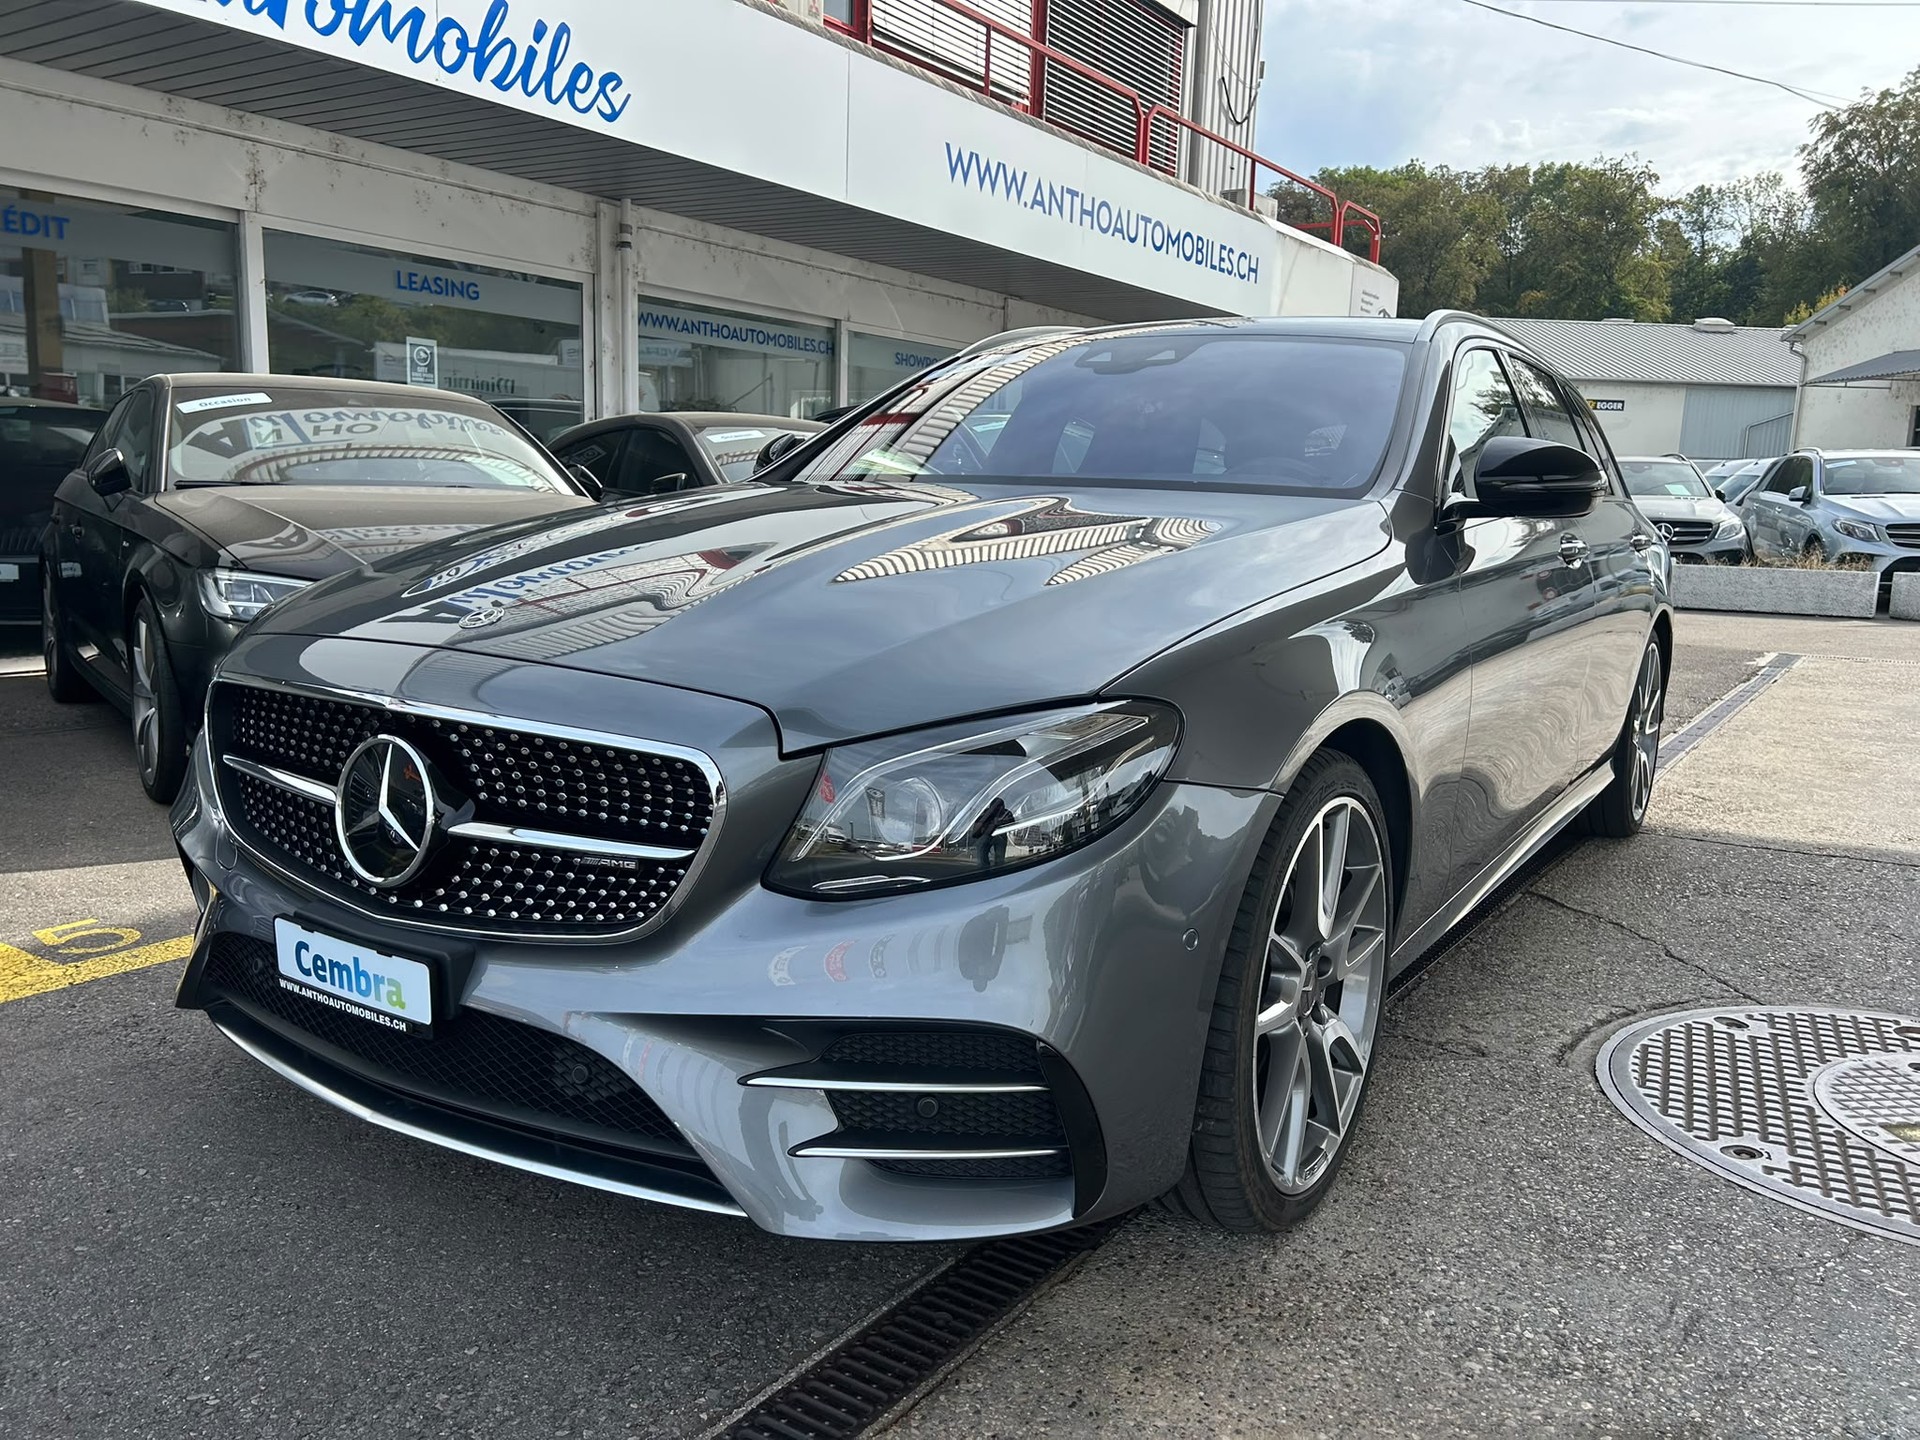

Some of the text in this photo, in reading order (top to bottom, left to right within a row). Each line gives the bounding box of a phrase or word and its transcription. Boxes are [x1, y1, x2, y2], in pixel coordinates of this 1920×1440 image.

[216, 0, 631, 123] omobiles
[945, 142, 1259, 284] WWW.ANTHOAUTOMOBILES.CH
[396, 270, 480, 300] LEASING
[638, 311, 835, 356] WWW.ANTHOAUTOMOBILES.CH
[895, 352, 943, 368] SHOWR
[199, 397, 252, 407] Occasion
[1596, 401, 1623, 410] EGGER
[597, 858, 637, 870] AMG
[32, 917, 142, 954] 5
[294, 940, 406, 1010] Cembra
[278, 978, 407, 1032] WWW.ANTHOAUTOMOBILES.CH
